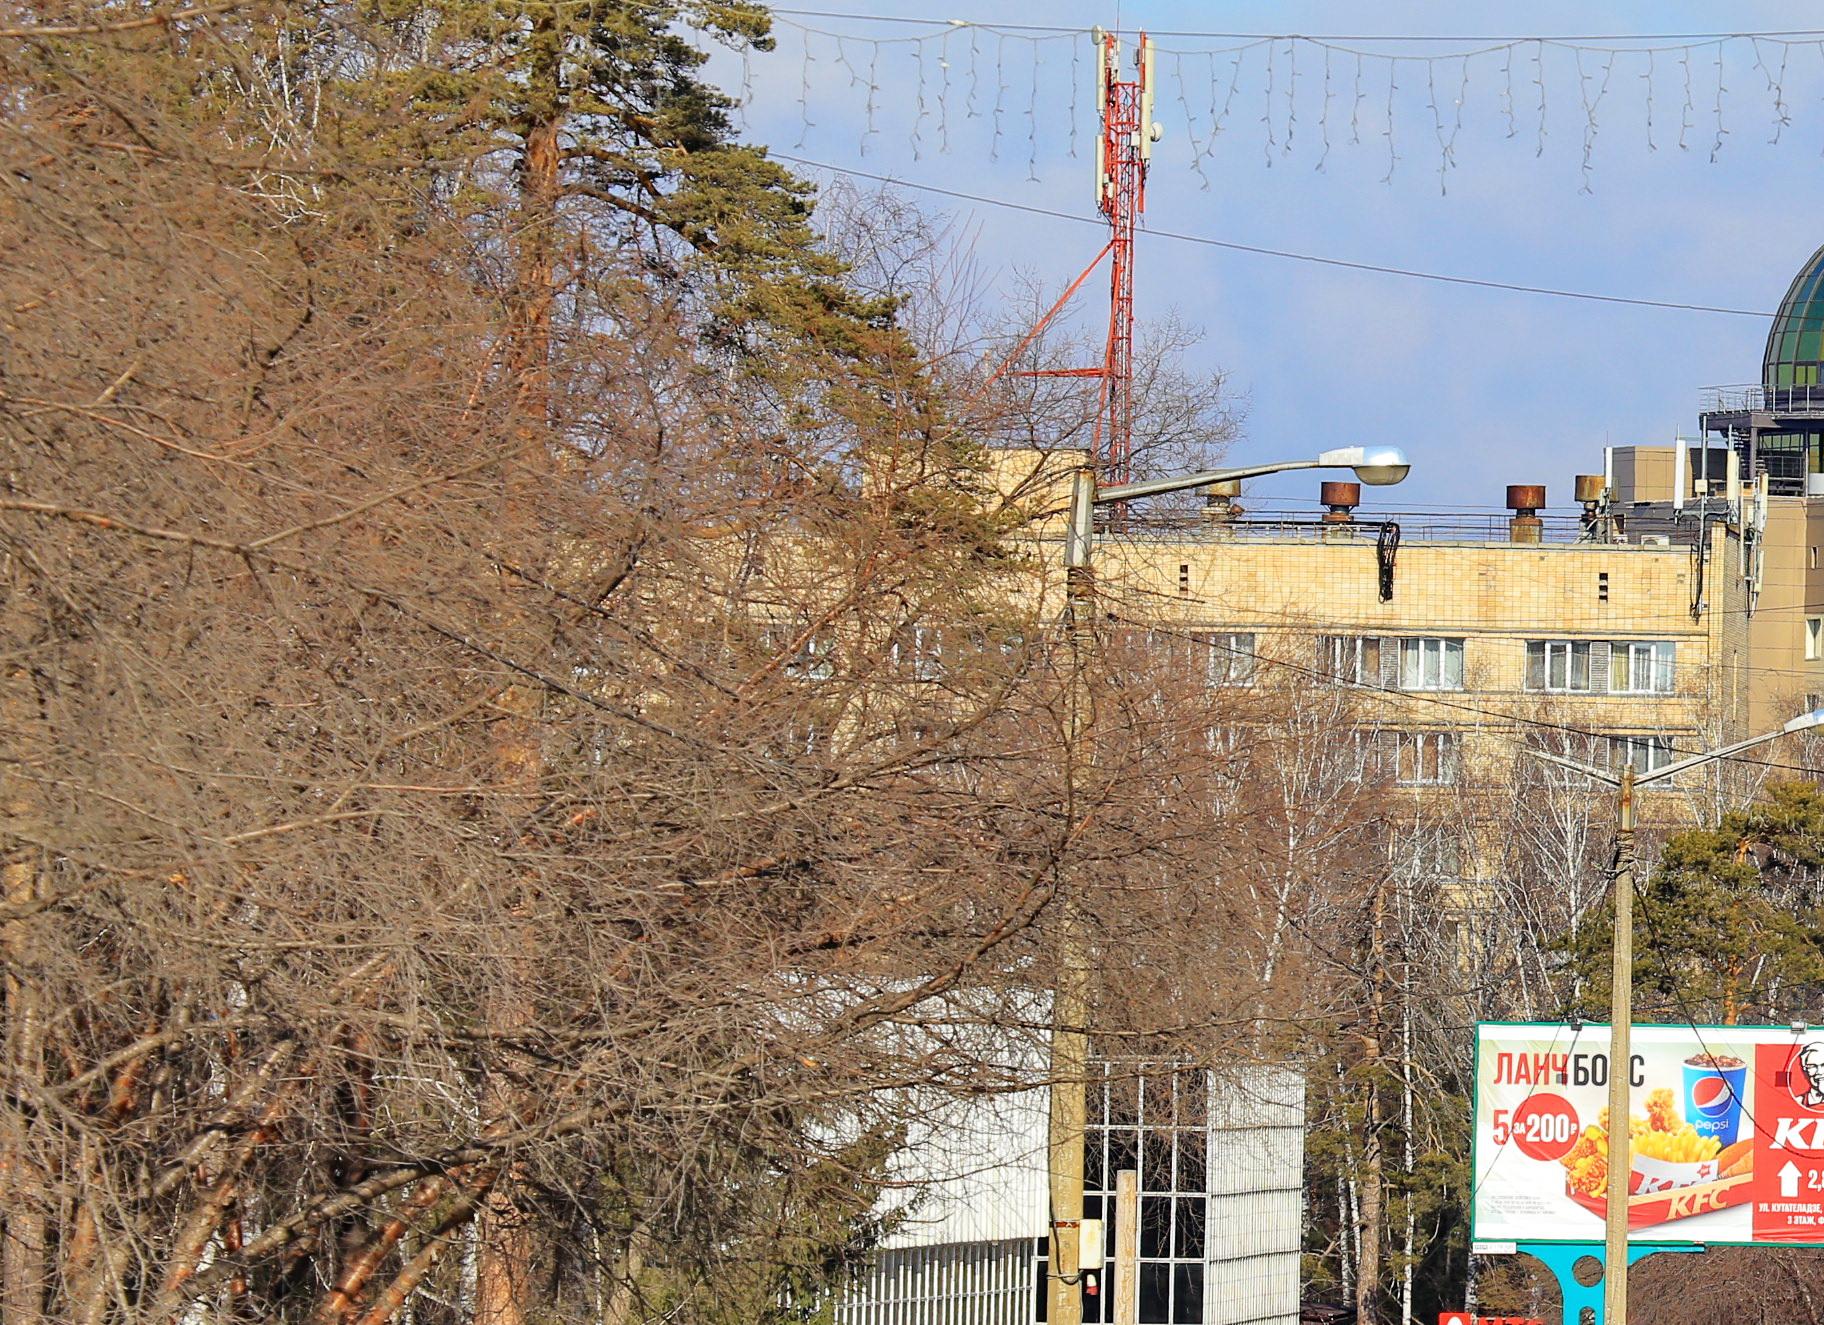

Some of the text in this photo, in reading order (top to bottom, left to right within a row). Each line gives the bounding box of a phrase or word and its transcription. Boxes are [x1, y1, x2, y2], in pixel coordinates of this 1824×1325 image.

[1574, 1054, 1645, 1087] БОС
[1493, 1110, 1509, 1145] 5
[1695, 1119, 1729, 1132] pepsi
[1665, 1186, 1730, 1220] KFC
